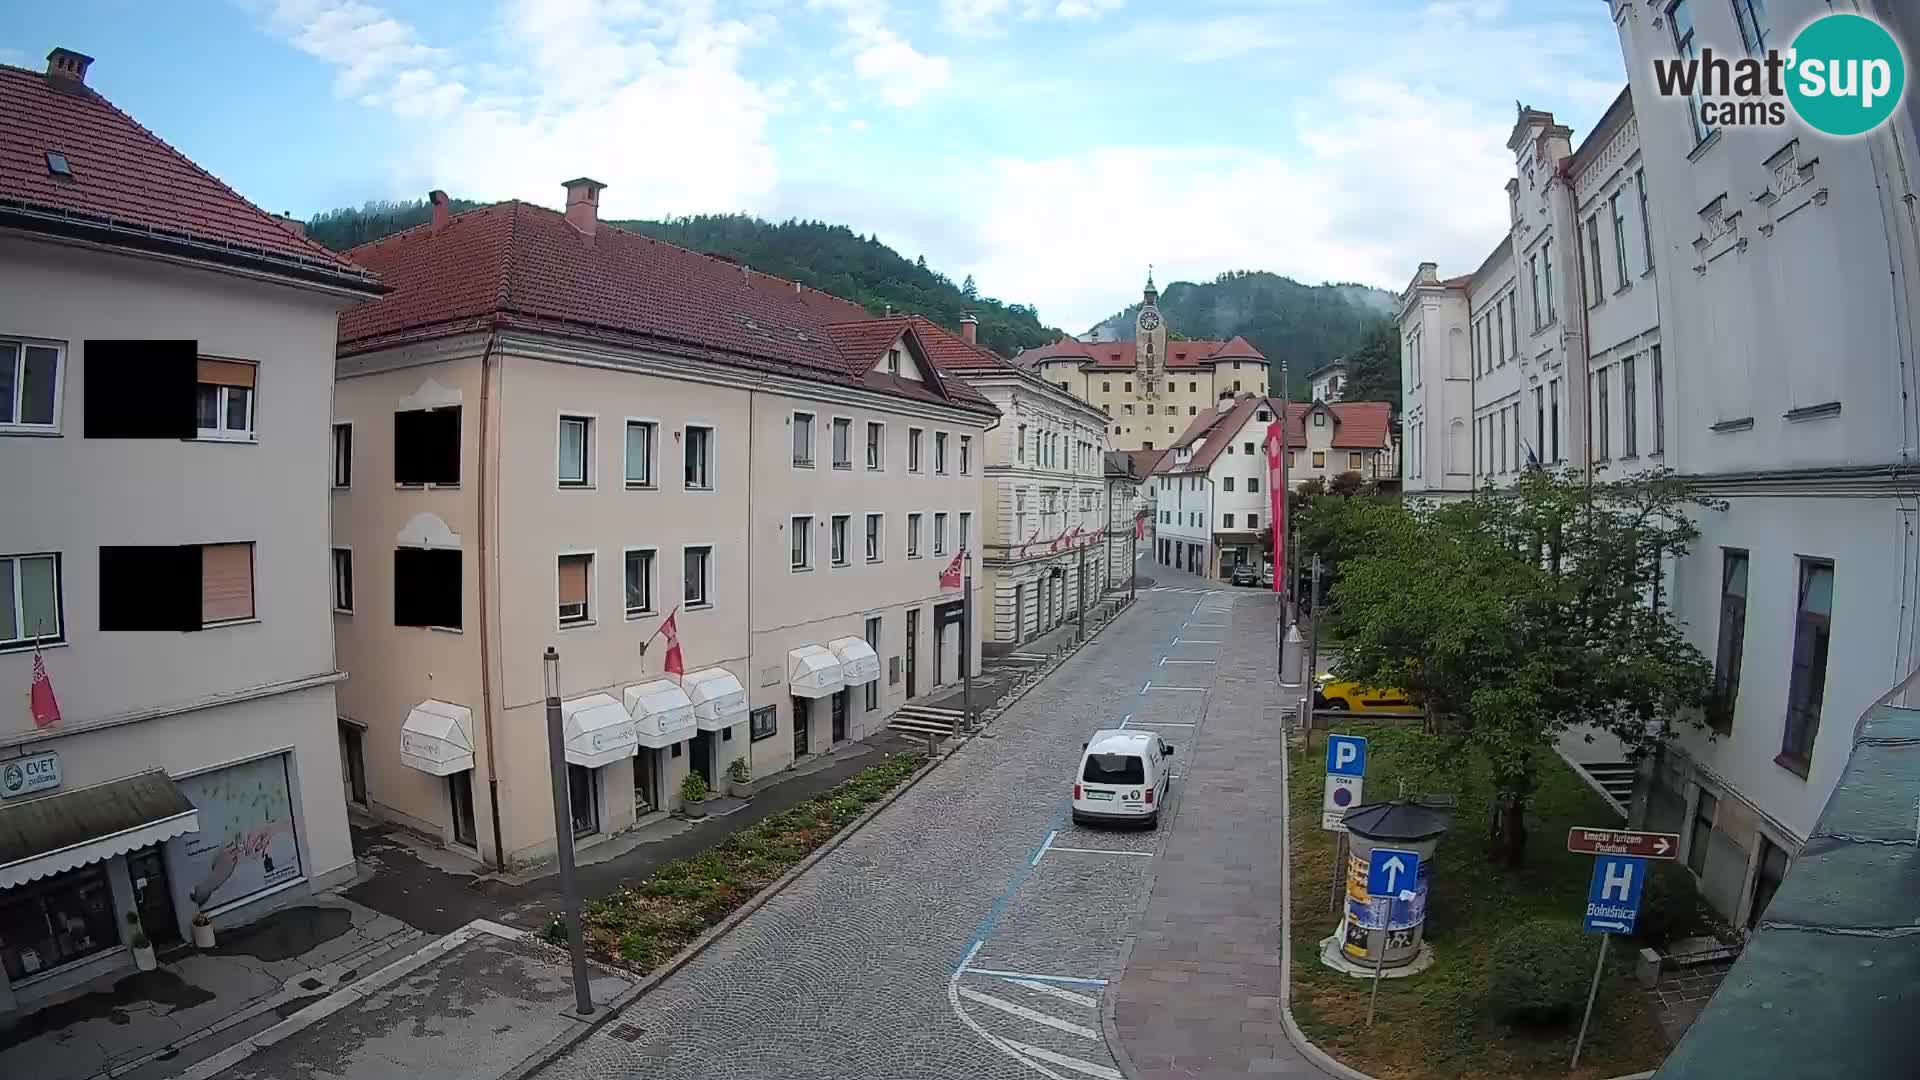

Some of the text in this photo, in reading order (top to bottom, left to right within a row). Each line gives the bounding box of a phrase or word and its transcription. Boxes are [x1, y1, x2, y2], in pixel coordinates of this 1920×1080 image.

[26, 758, 55, 775] CVET
[1335, 741, 1357, 769] P
[1601, 862, 1634, 901] H
[1586, 902, 1636, 920] Bolnišnica
